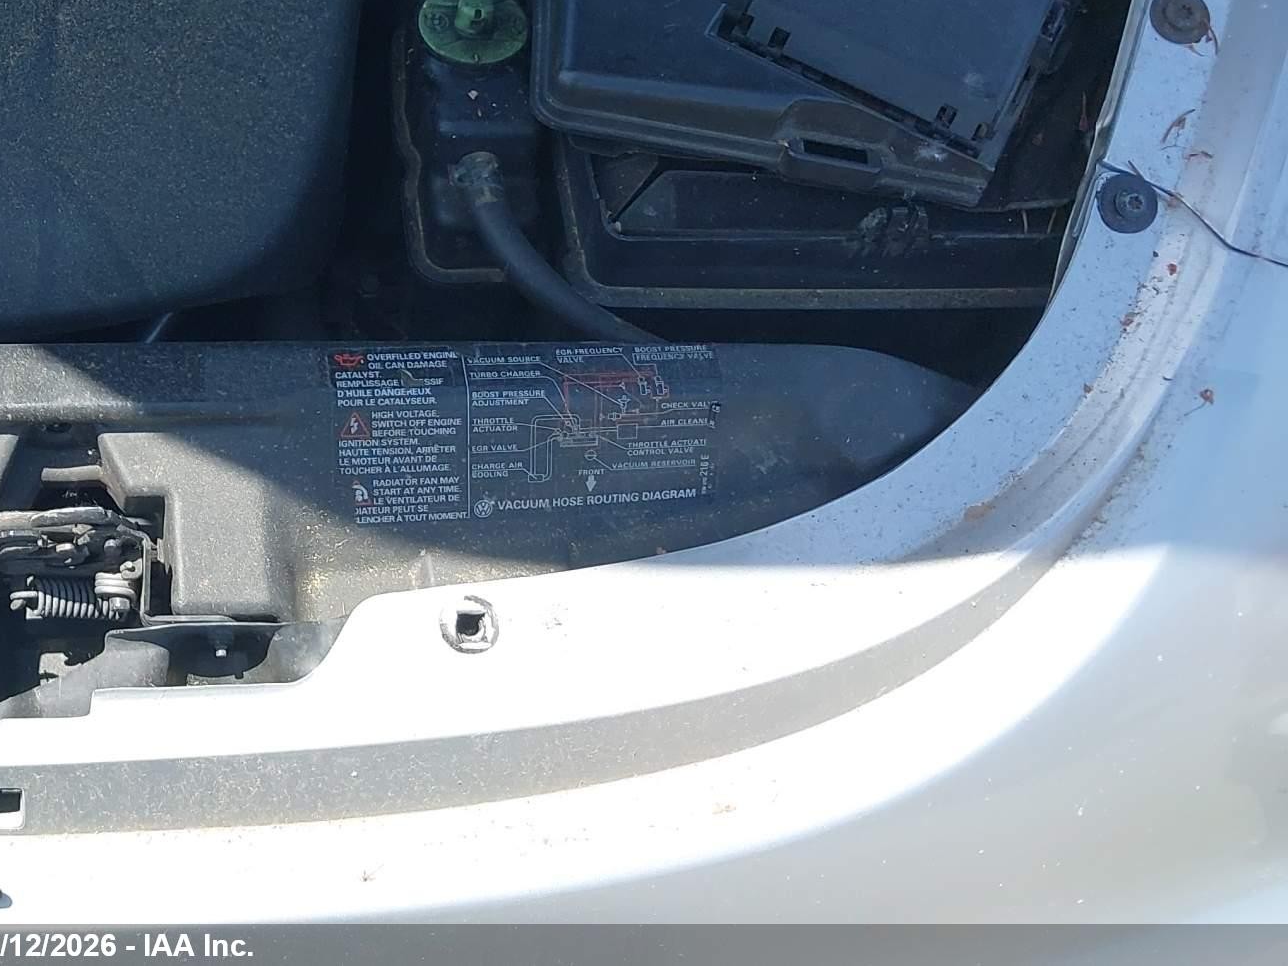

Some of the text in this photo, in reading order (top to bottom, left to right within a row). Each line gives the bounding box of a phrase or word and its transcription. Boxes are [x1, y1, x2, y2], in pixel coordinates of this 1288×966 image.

[367, 352, 421, 361] OVERFILLED
[368, 360, 448, 370] OIL CAN DAMAGE
[335, 370, 382, 379] CATALYST.
[336, 379, 399, 388] REMPLISSAGE
[337, 387, 432, 398] D'HUILE DANGEREUX
[502, 389, 545, 397] PRESSURE
[337, 396, 437, 407] POUR LE CATALYSEUR.
[472, 398, 529, 407] ADJUSTMENT
[372, 410, 394, 419] HIGH
[371, 418, 462, 428] SWITCH OFF ENGINE
[661, 418, 676, 426] AIR
[372, 427, 456, 437] BEFORE TOUCHING
[472, 425, 518, 433] ACTUATOR
[338, 438, 420, 448] IGNITION SYSTEM.
[339, 448, 369, 457] HAUTE
[472, 444, 488, 452] EGR
[626, 448, 666, 456] CONTROL
[339, 455, 437, 466] LE MOTEUR AVANT DE
[612, 459, 696, 469] VACUUM RESERVOIR
[339, 466, 383, 475] TOUCHER
[472, 470, 510, 478] COOLING
[373, 476, 460, 487] RADIATOR FAN MAY
[373, 485, 462, 496] START AT ANY TIME.
[374, 494, 460, 505] LE VENTILATEUR DE
[497, 488, 697, 511] VACUUM HOSE ROUTING DIAGRAM
[392, 505, 415, 514] PEUT
[404, 514, 427, 522] TOUT
